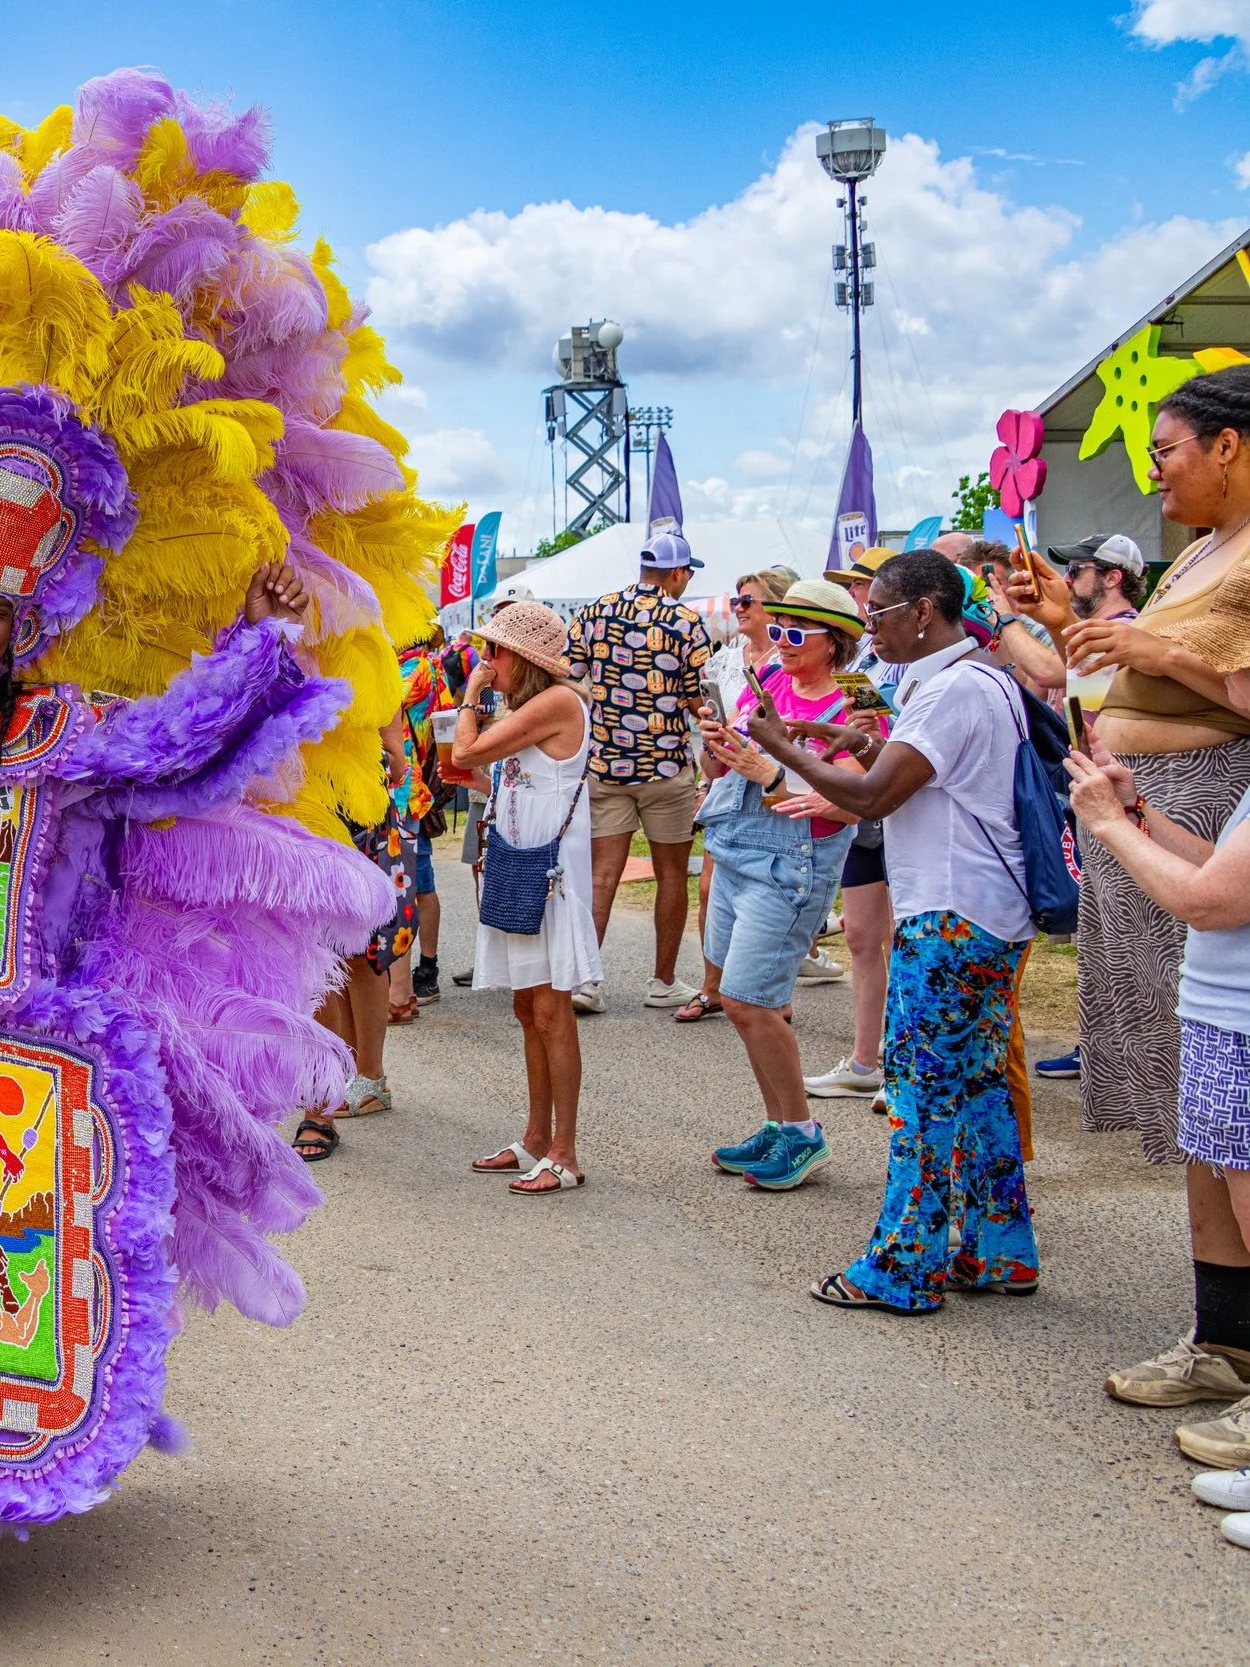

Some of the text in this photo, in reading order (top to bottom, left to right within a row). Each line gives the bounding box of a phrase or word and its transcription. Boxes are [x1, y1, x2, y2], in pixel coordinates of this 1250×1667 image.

[844, 524, 866, 542] Lite
[508, 589, 516, 597] P
[791, 1146, 813, 1169] HOKA
